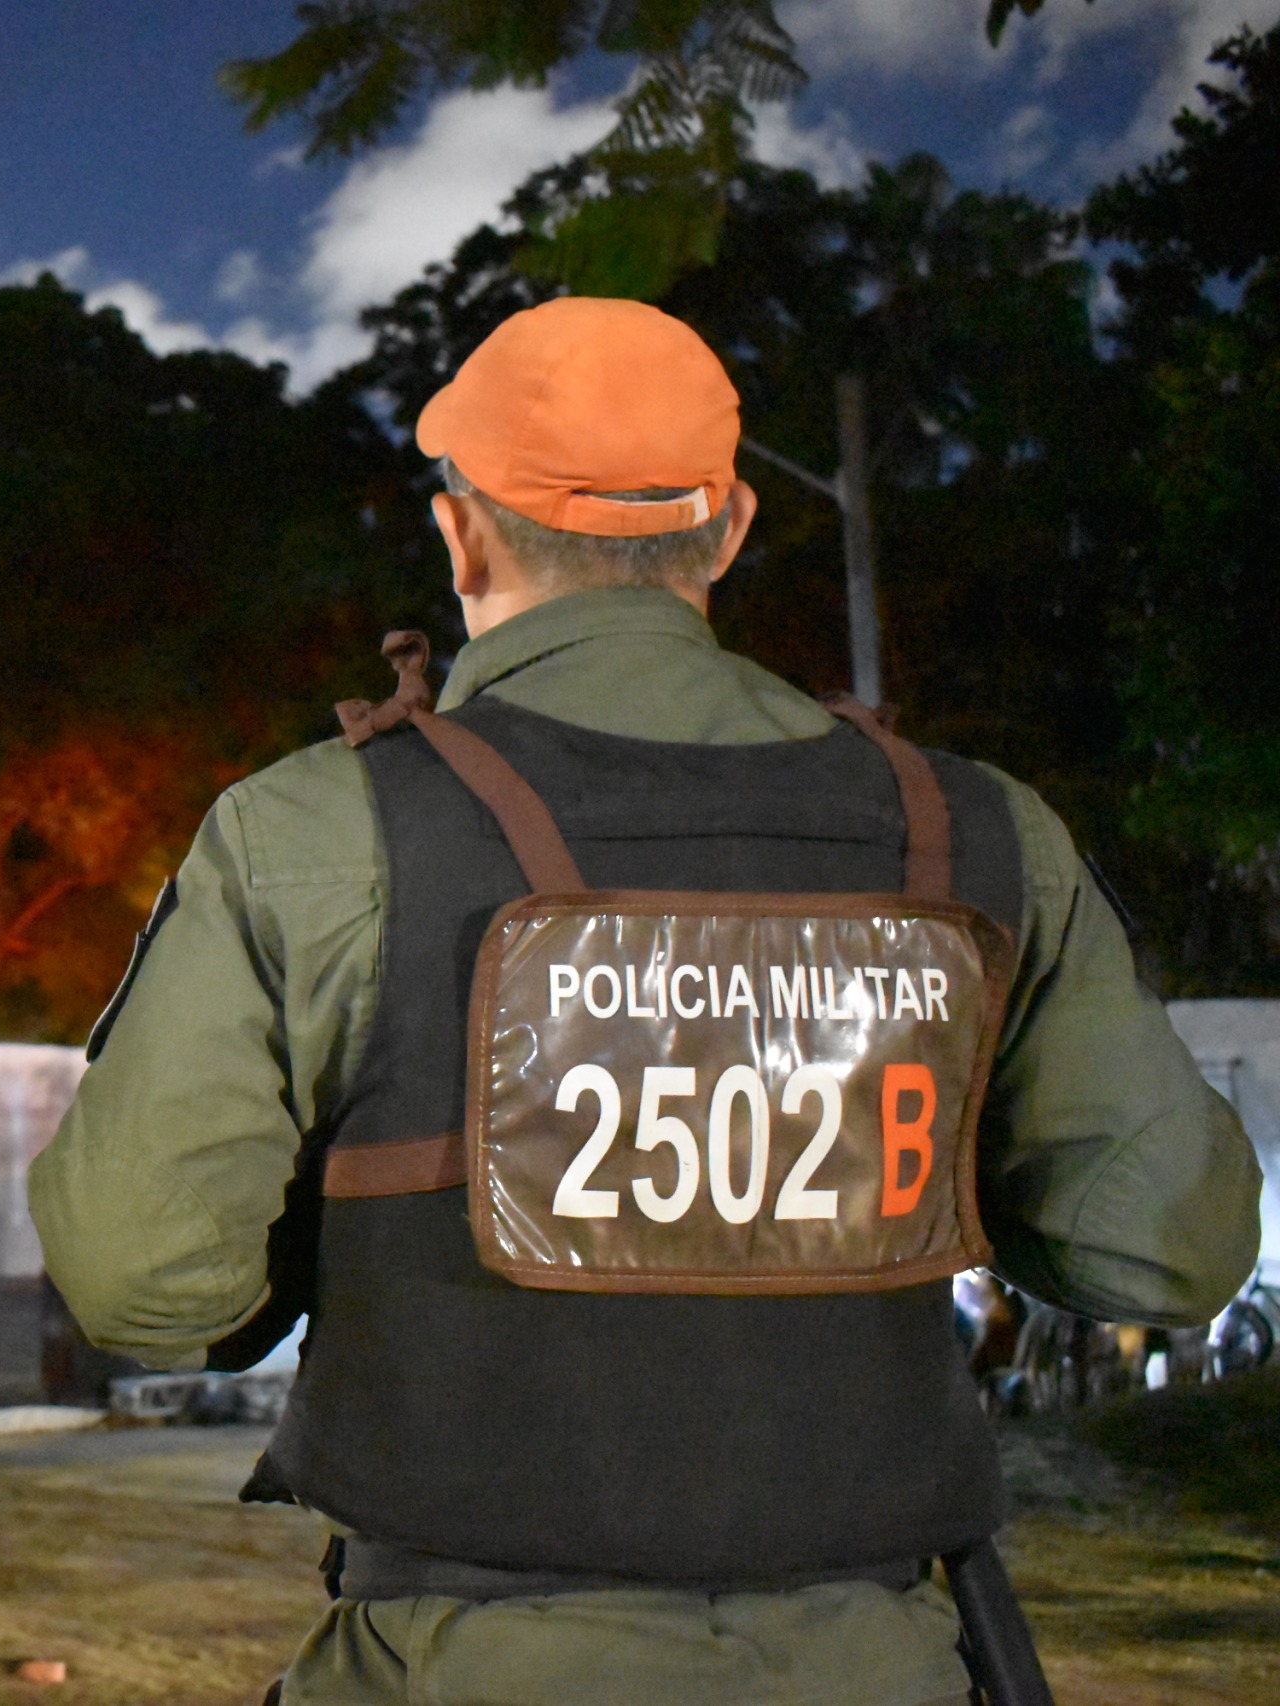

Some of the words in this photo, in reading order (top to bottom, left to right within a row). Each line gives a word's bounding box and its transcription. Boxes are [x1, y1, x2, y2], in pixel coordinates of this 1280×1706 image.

[549, 952, 760, 1019] POLÍCIA
[770, 965, 949, 1022] MILITAR
[552, 1063, 843, 1224] 2502
[881, 1063, 937, 1218] B
